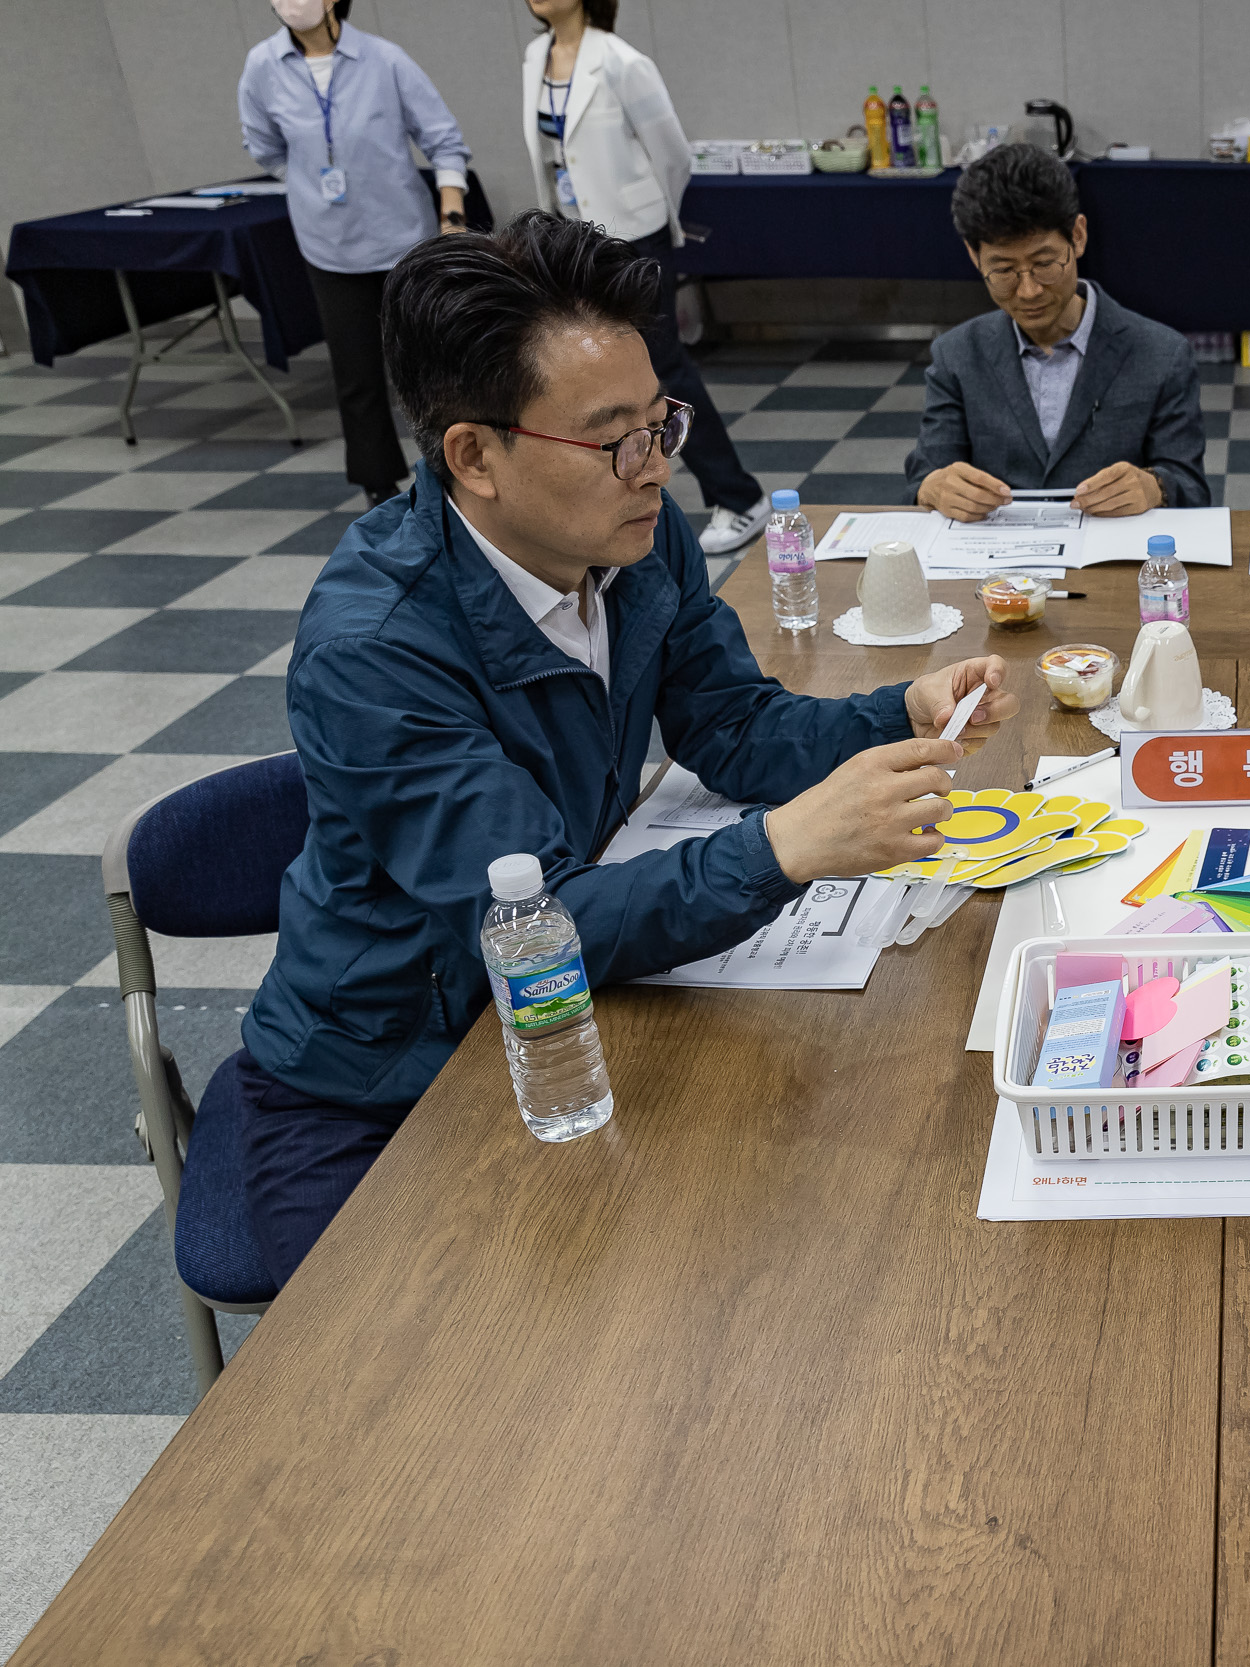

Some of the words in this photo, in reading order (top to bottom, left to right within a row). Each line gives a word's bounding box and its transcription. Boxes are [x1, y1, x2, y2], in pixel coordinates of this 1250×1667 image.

[779, 552, 805, 561] 아이시스
[1168, 749, 1204, 788] 행
[523, 972, 579, 998] SamDaSoo
[525, 1018, 549, 1028] NATURAL
[1033, 1176, 1087, 1187] 왜냐하면
